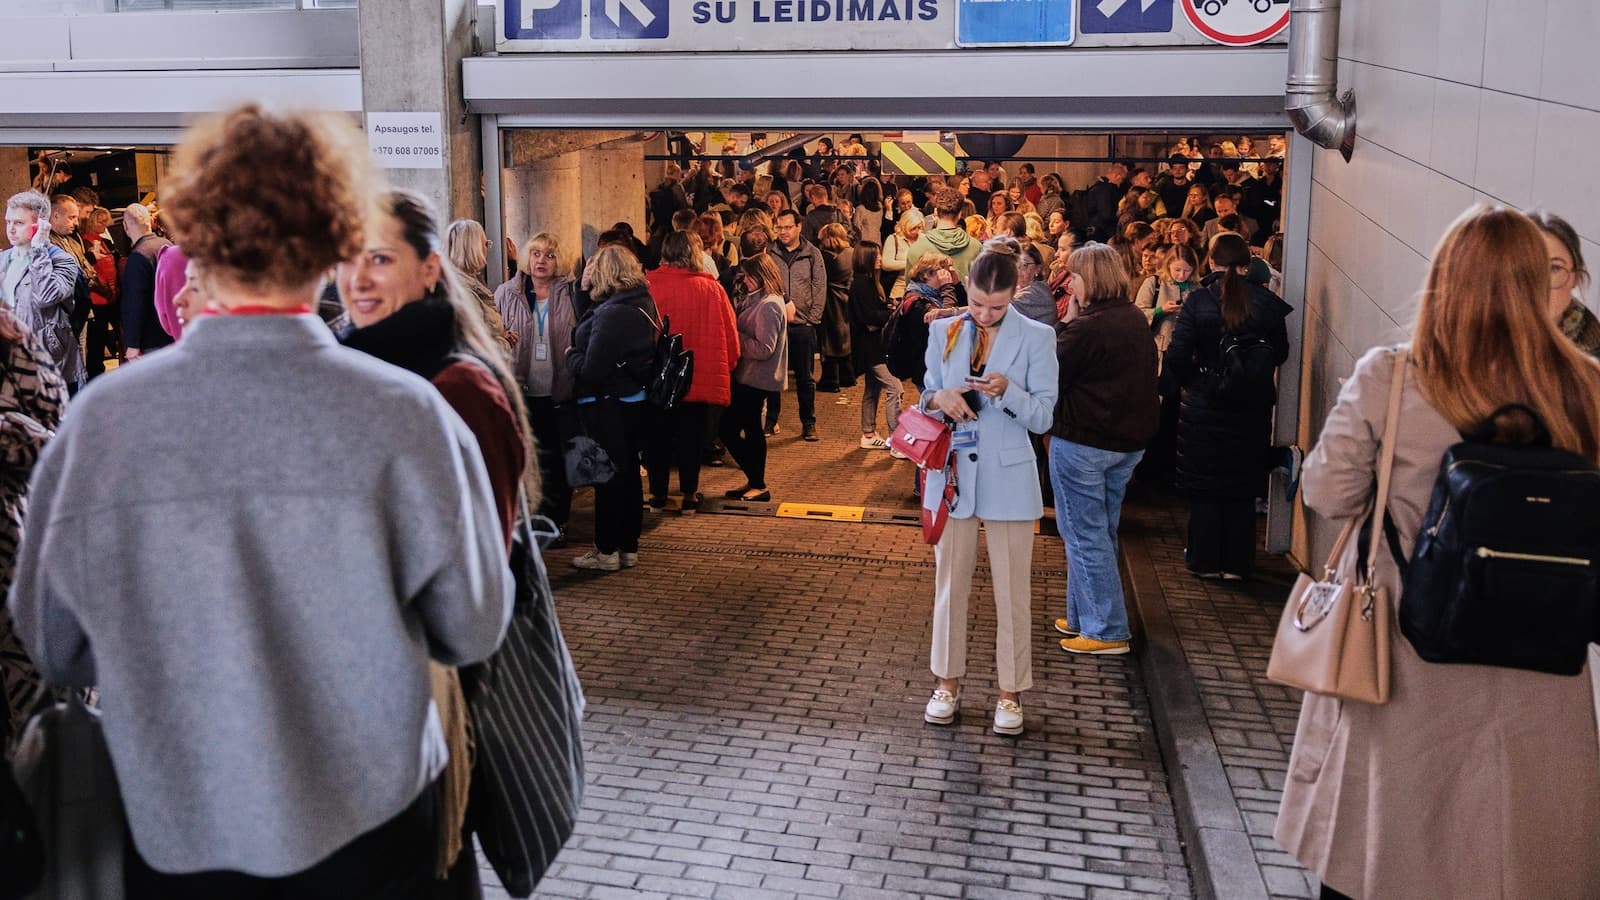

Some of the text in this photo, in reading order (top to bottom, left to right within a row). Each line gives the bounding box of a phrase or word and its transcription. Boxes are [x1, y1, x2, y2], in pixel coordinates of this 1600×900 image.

[692, 0, 938, 24] SU LEIDIMAIS
[374, 124, 435, 135] Apsaugos tel.
[395, 146, 411, 155] 608
[413, 146, 439, 155] 07005
